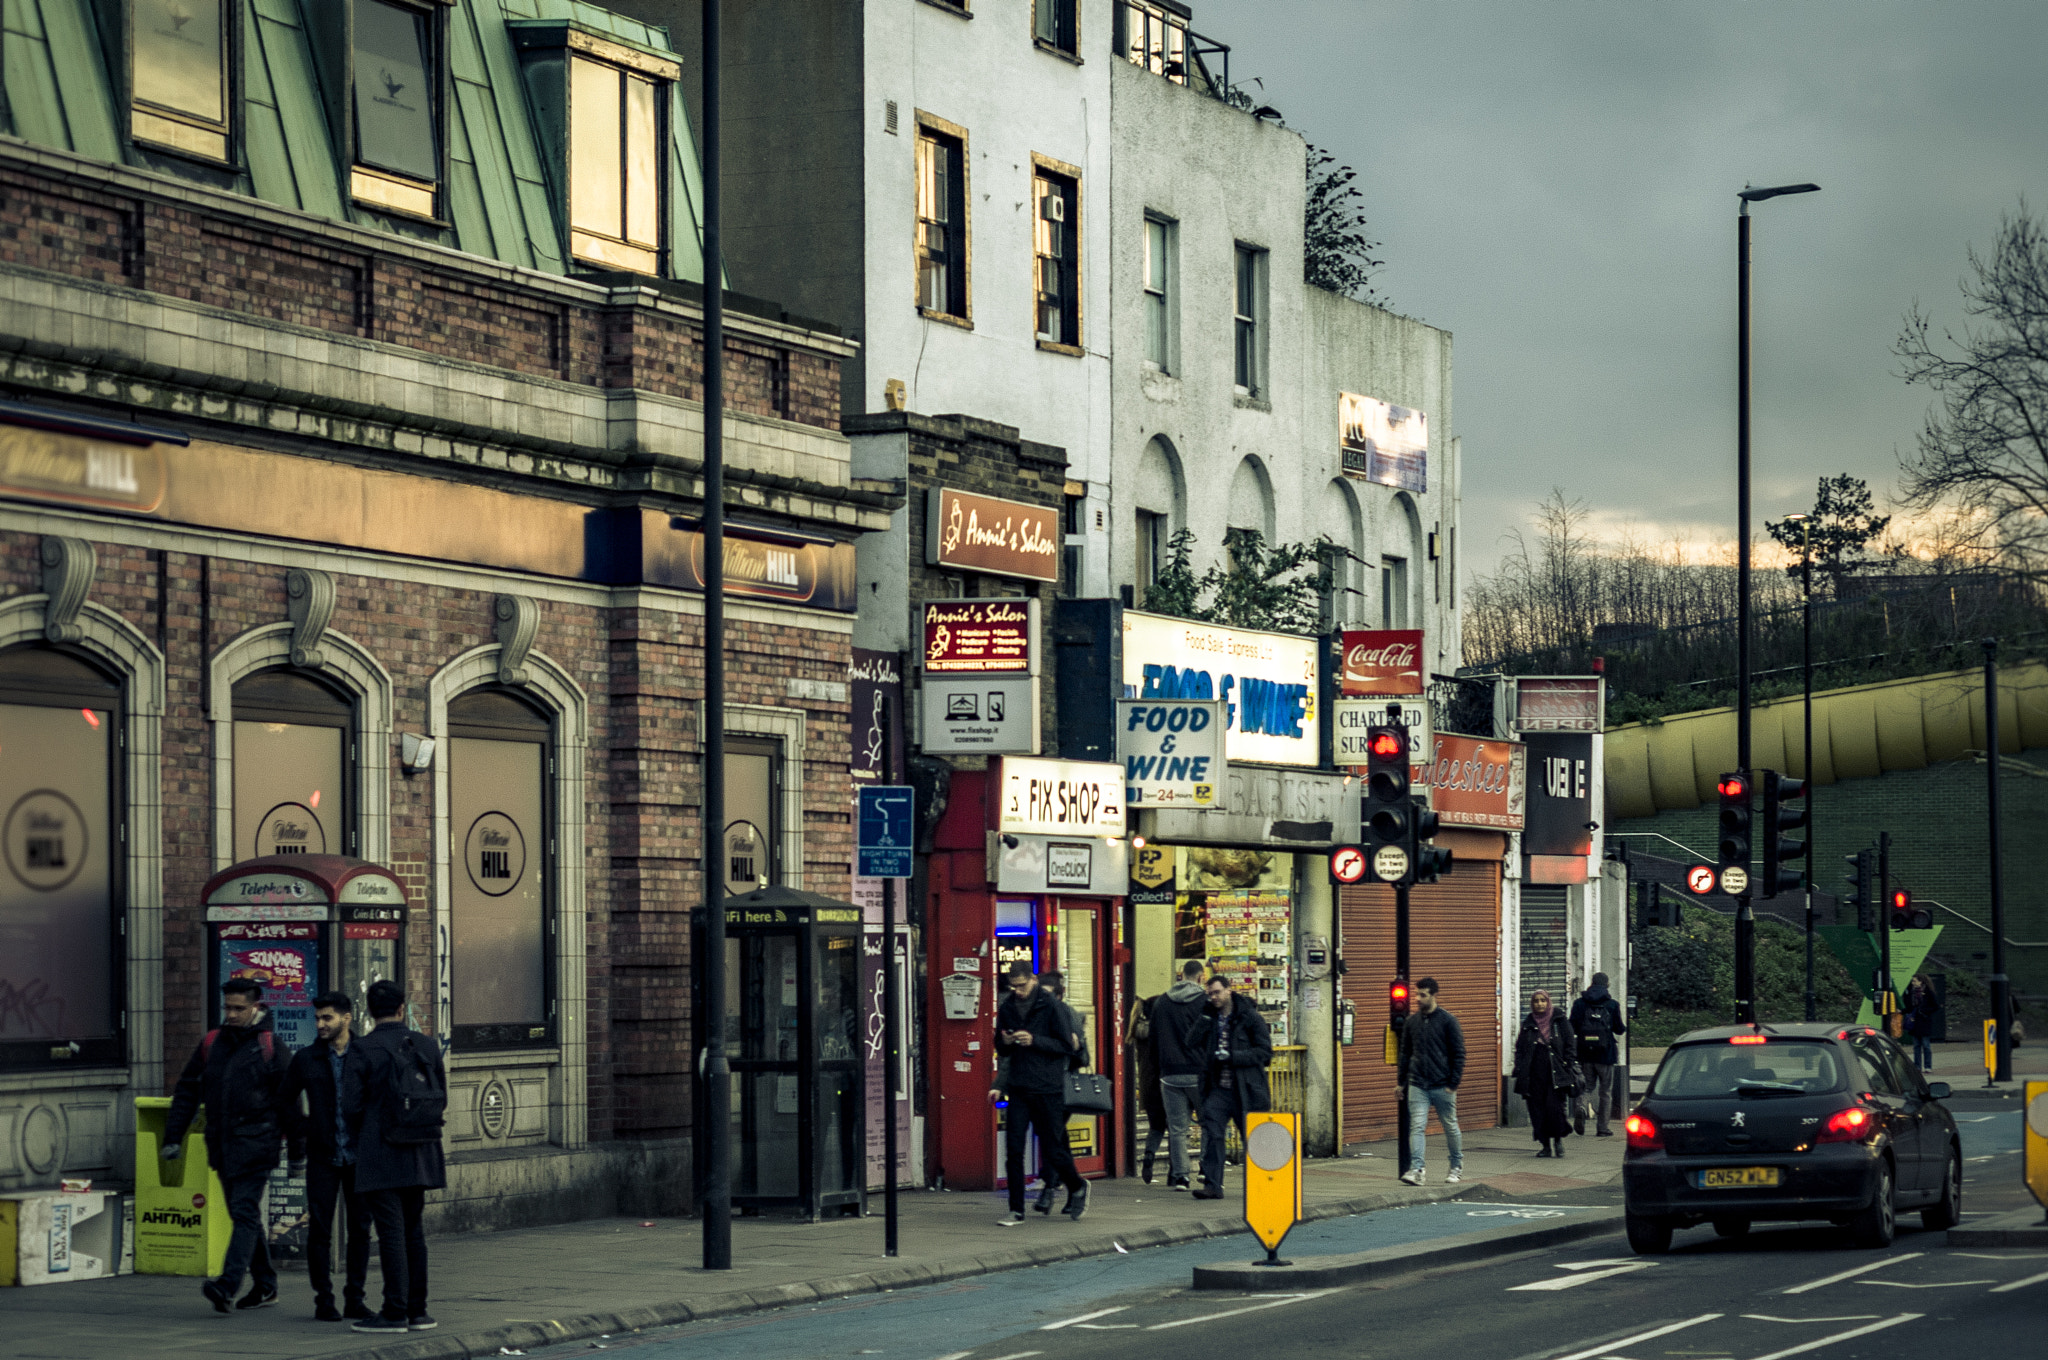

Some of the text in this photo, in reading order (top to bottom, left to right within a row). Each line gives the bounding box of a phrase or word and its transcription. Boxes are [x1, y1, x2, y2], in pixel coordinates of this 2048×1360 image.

[965, 508, 1056, 556] Annie's Salon
[767, 549, 798, 586] HILL
[926, 603, 1027, 624] Annie's Salon
[1185, 630, 1205, 651] Food
[1228, 637, 1258, 660] Express
[1127, 706, 1211, 733] FOOD
[1340, 709, 1422, 728] CHARTED
[1159, 734, 1176, 754] &
[1127, 755, 1211, 782] WINE
[1029, 779, 1100, 825] FIX SHOP
[1157, 789, 1174, 801] 24
[887, 850, 909, 858] TURN
[481, 850, 511, 879] HILL
[731, 857, 756, 882] HILL
[869, 866, 900, 874] STAGES
[1139, 865, 1154, 874] Pay
[1139, 872, 1162, 881] Point
[357, 881, 388, 898] Telephone
[745, 909, 772, 923] here
[998, 945, 1032, 961] Free Cash
[1801, 1117, 1819, 1125] 307
[1707, 1170, 1743, 1185] GN52
[142, 1211, 202, 1229] АНГЛИЯ
